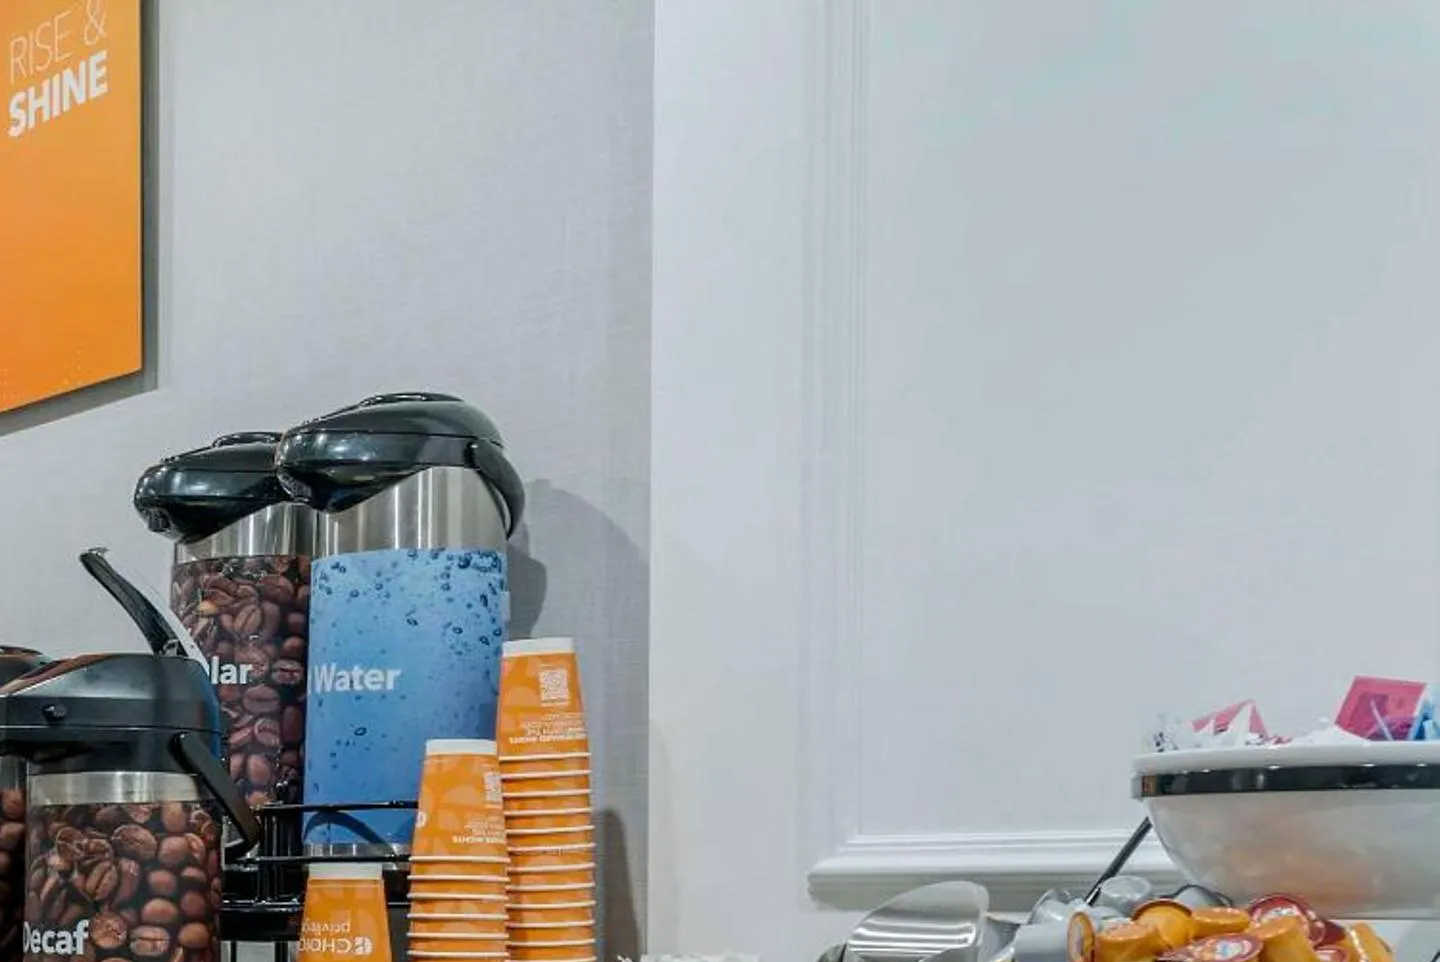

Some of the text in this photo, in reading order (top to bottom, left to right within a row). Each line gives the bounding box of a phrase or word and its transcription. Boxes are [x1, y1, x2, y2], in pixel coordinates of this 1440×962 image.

[9, 0, 107, 84] RISE &
[7, 50, 108, 137] SHINE
[210, 655, 253, 684] lar
[314, 662, 402, 695] Water
[22, 919, 90, 955] Decaf
